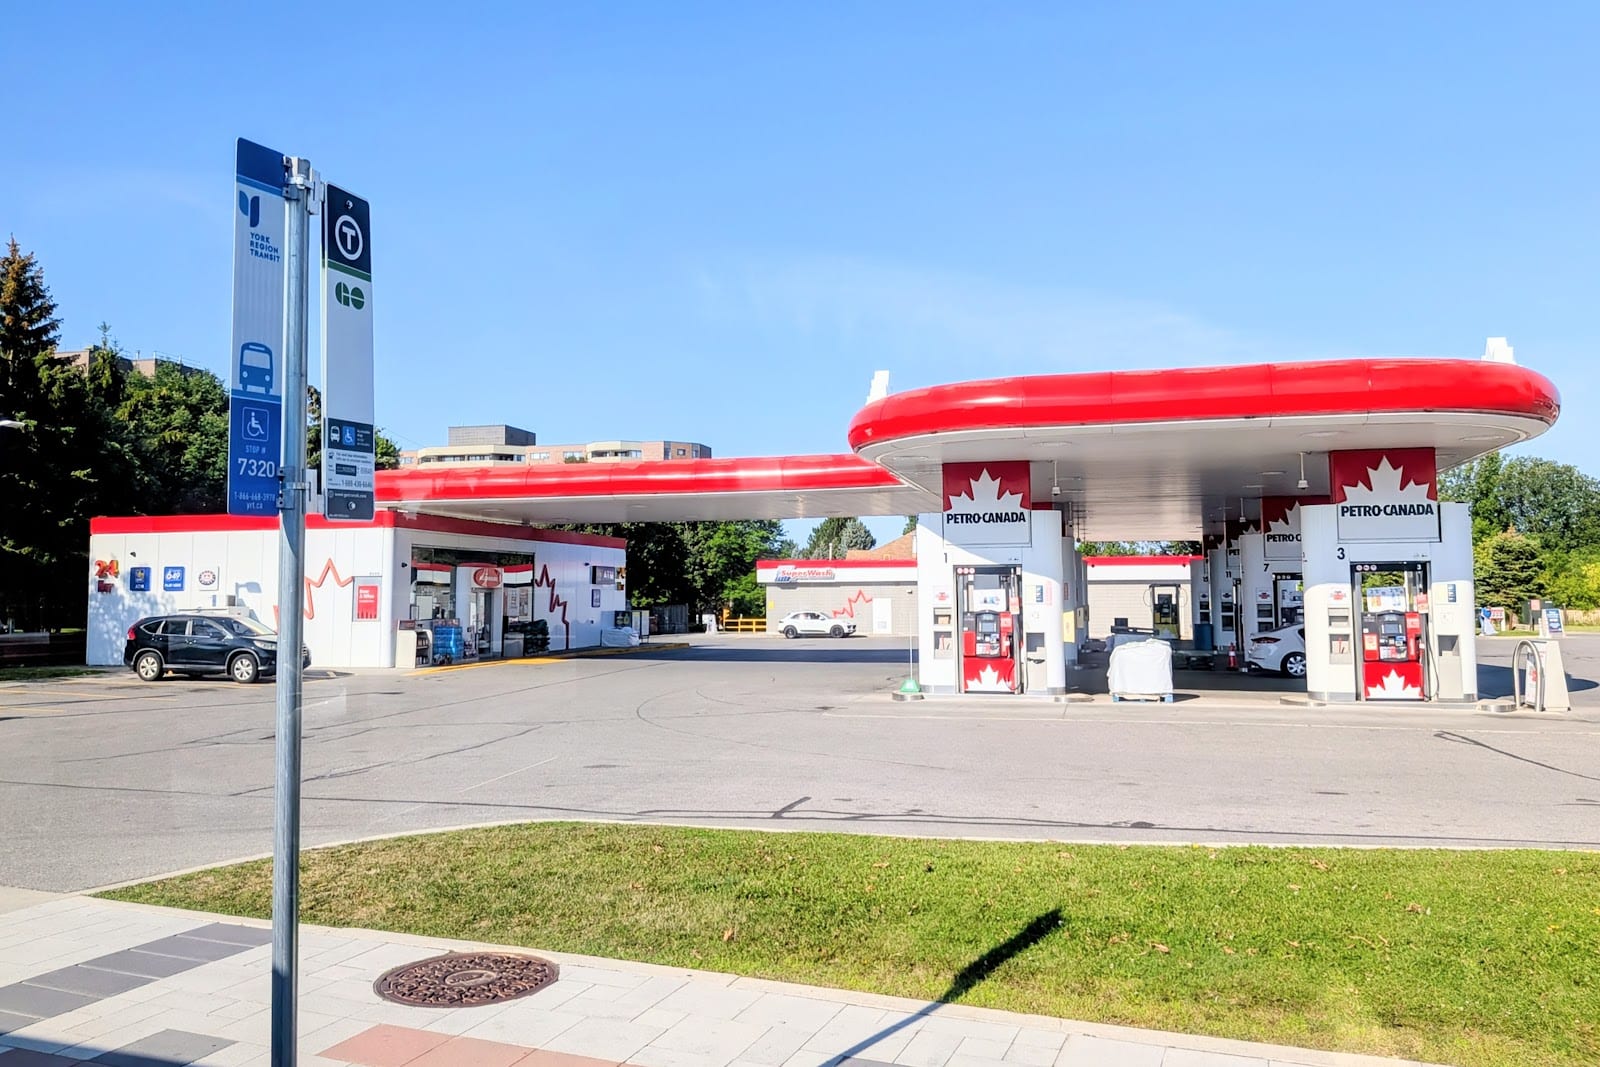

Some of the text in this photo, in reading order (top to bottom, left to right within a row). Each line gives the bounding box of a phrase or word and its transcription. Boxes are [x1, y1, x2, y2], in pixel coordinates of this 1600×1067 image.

[250, 231, 271, 244] YORK
[342, 225, 356, 250] T
[250, 240, 279, 254] REGION
[250, 248, 281, 263] TRANSIT
[335, 281, 365, 310] GO
[245, 445, 260, 454] STOP
[237, 457, 276, 478] 7320
[246, 502, 263, 511] yrt.ca
[943, 552, 948, 564] 1
[1336, 547, 1345, 560] 3
[94, 559, 120, 579] 24
[1263, 563, 1270, 572] 7
[603, 570, 614, 580] ATM
